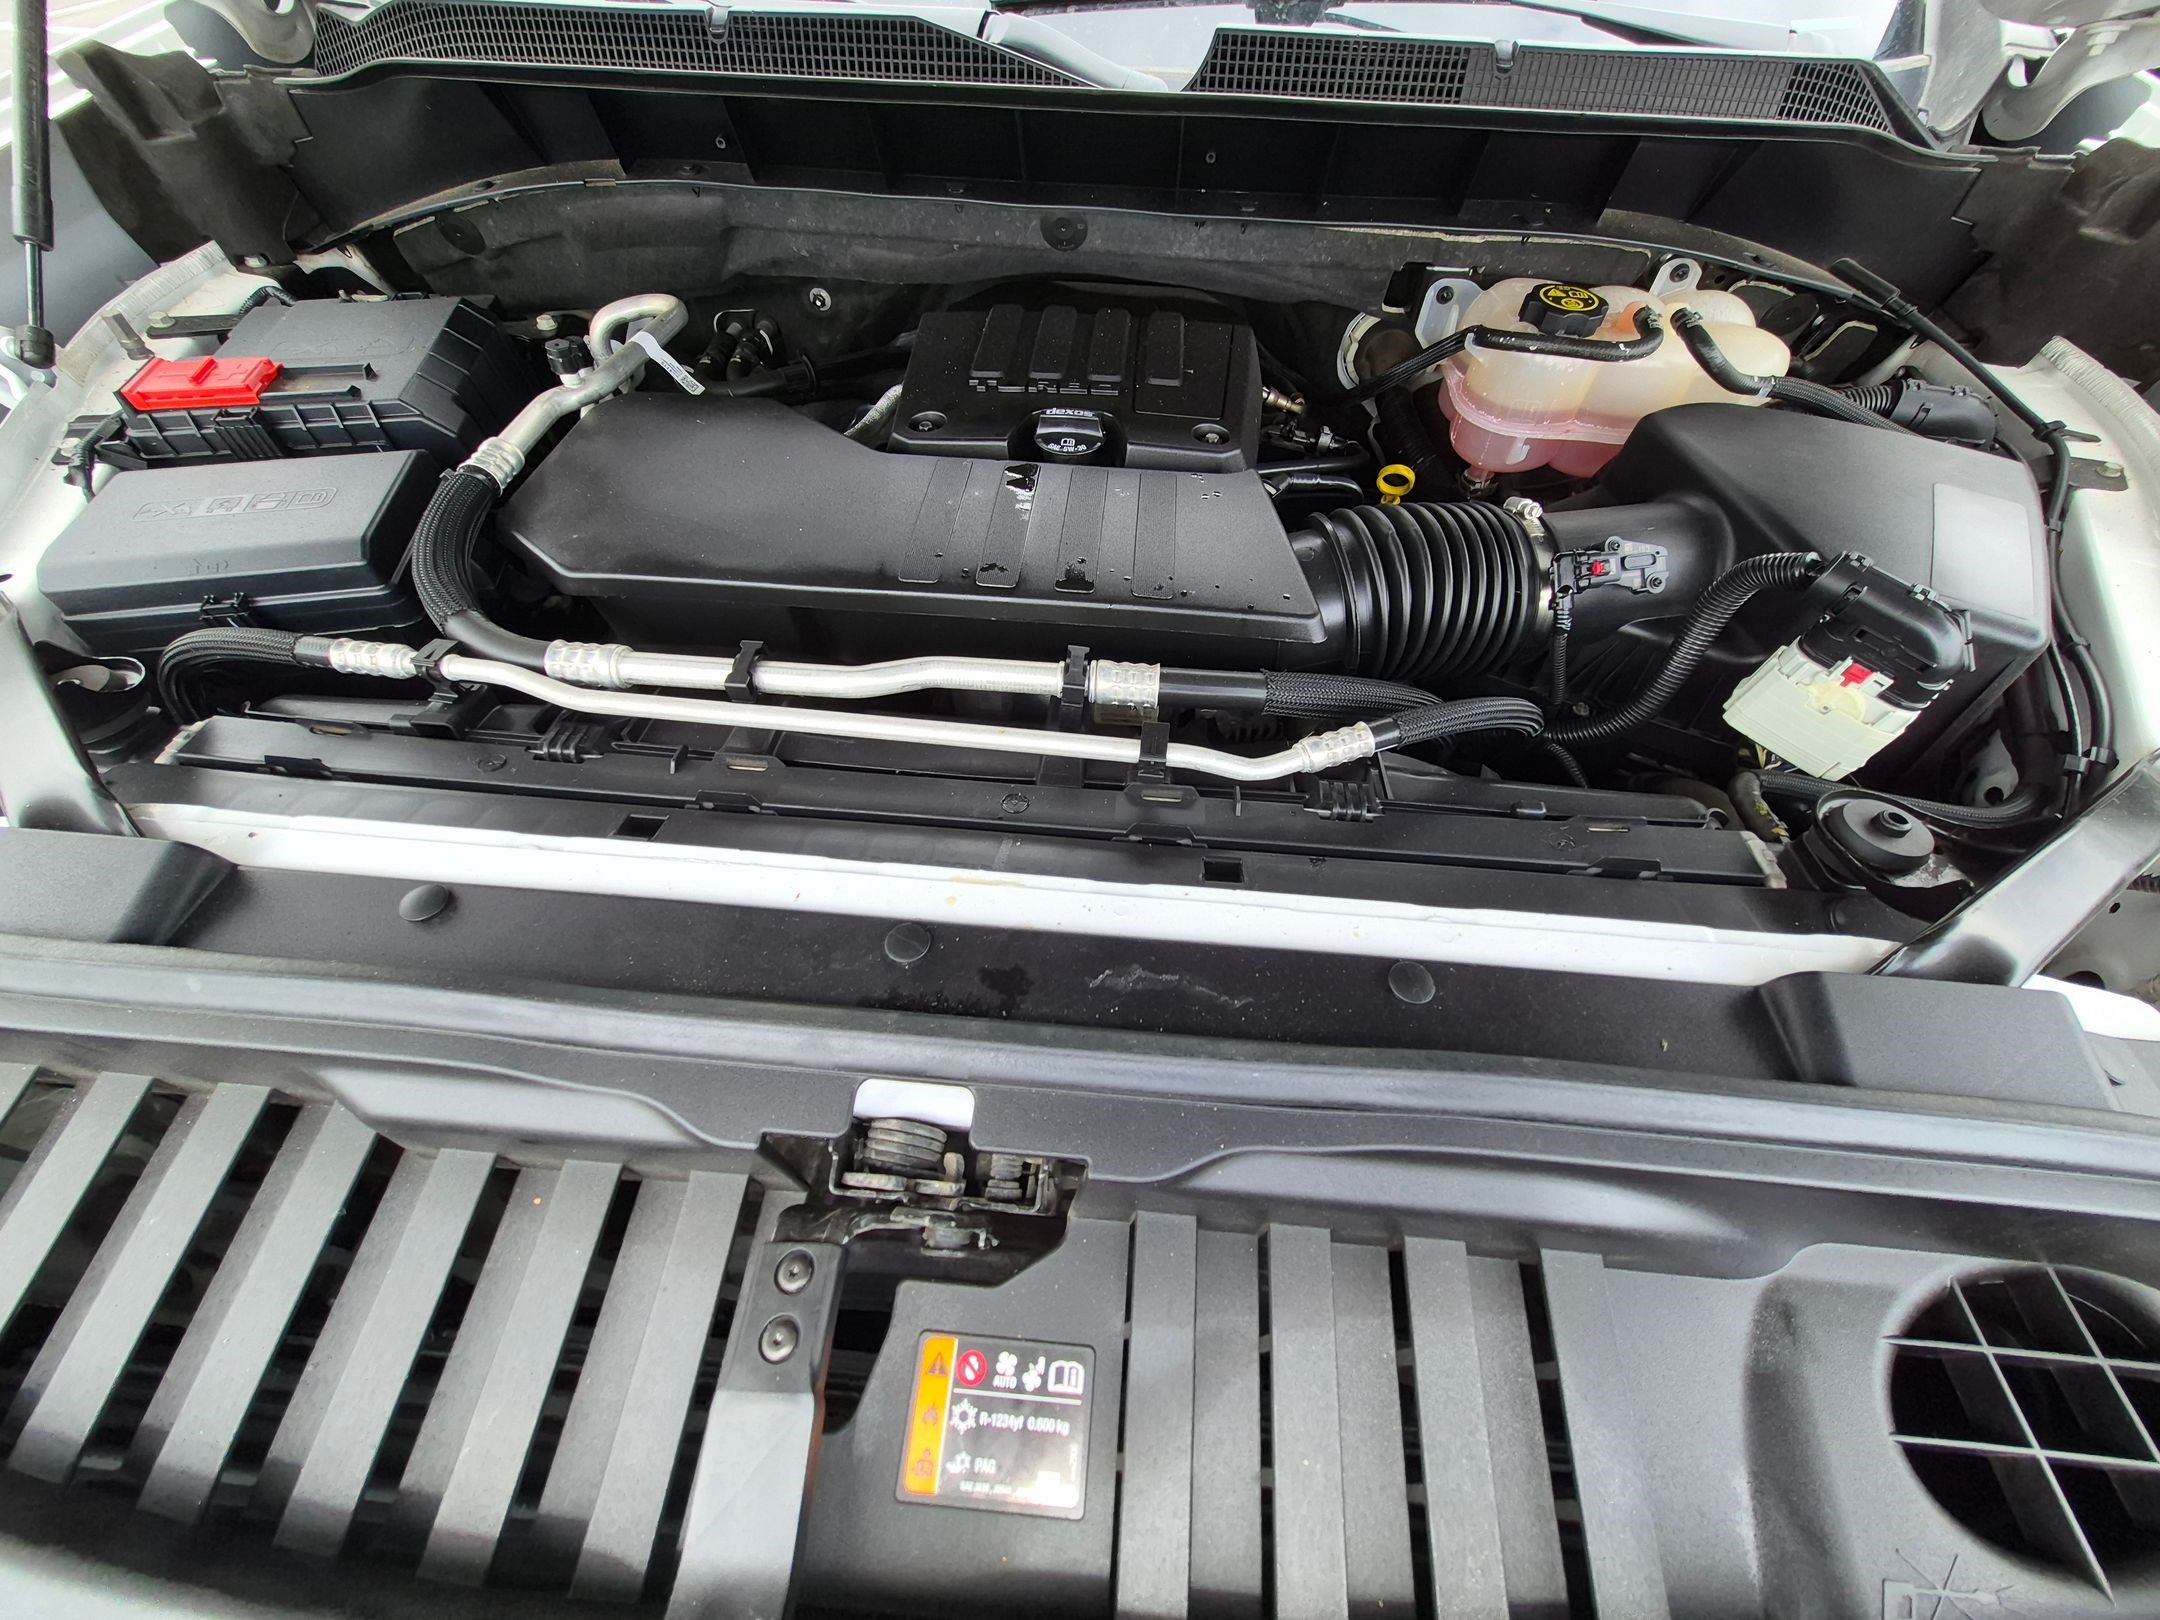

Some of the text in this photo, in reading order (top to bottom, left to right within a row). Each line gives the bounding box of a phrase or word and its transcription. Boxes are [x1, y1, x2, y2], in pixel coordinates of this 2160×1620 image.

[1046, 407, 1093, 417] dexos
[993, 1374, 1018, 1389] AUTO
[979, 1411, 1025, 1433] R-1234yf
[1056, 1419, 1070, 1437] kg
[974, 1457, 997, 1474] PAG
